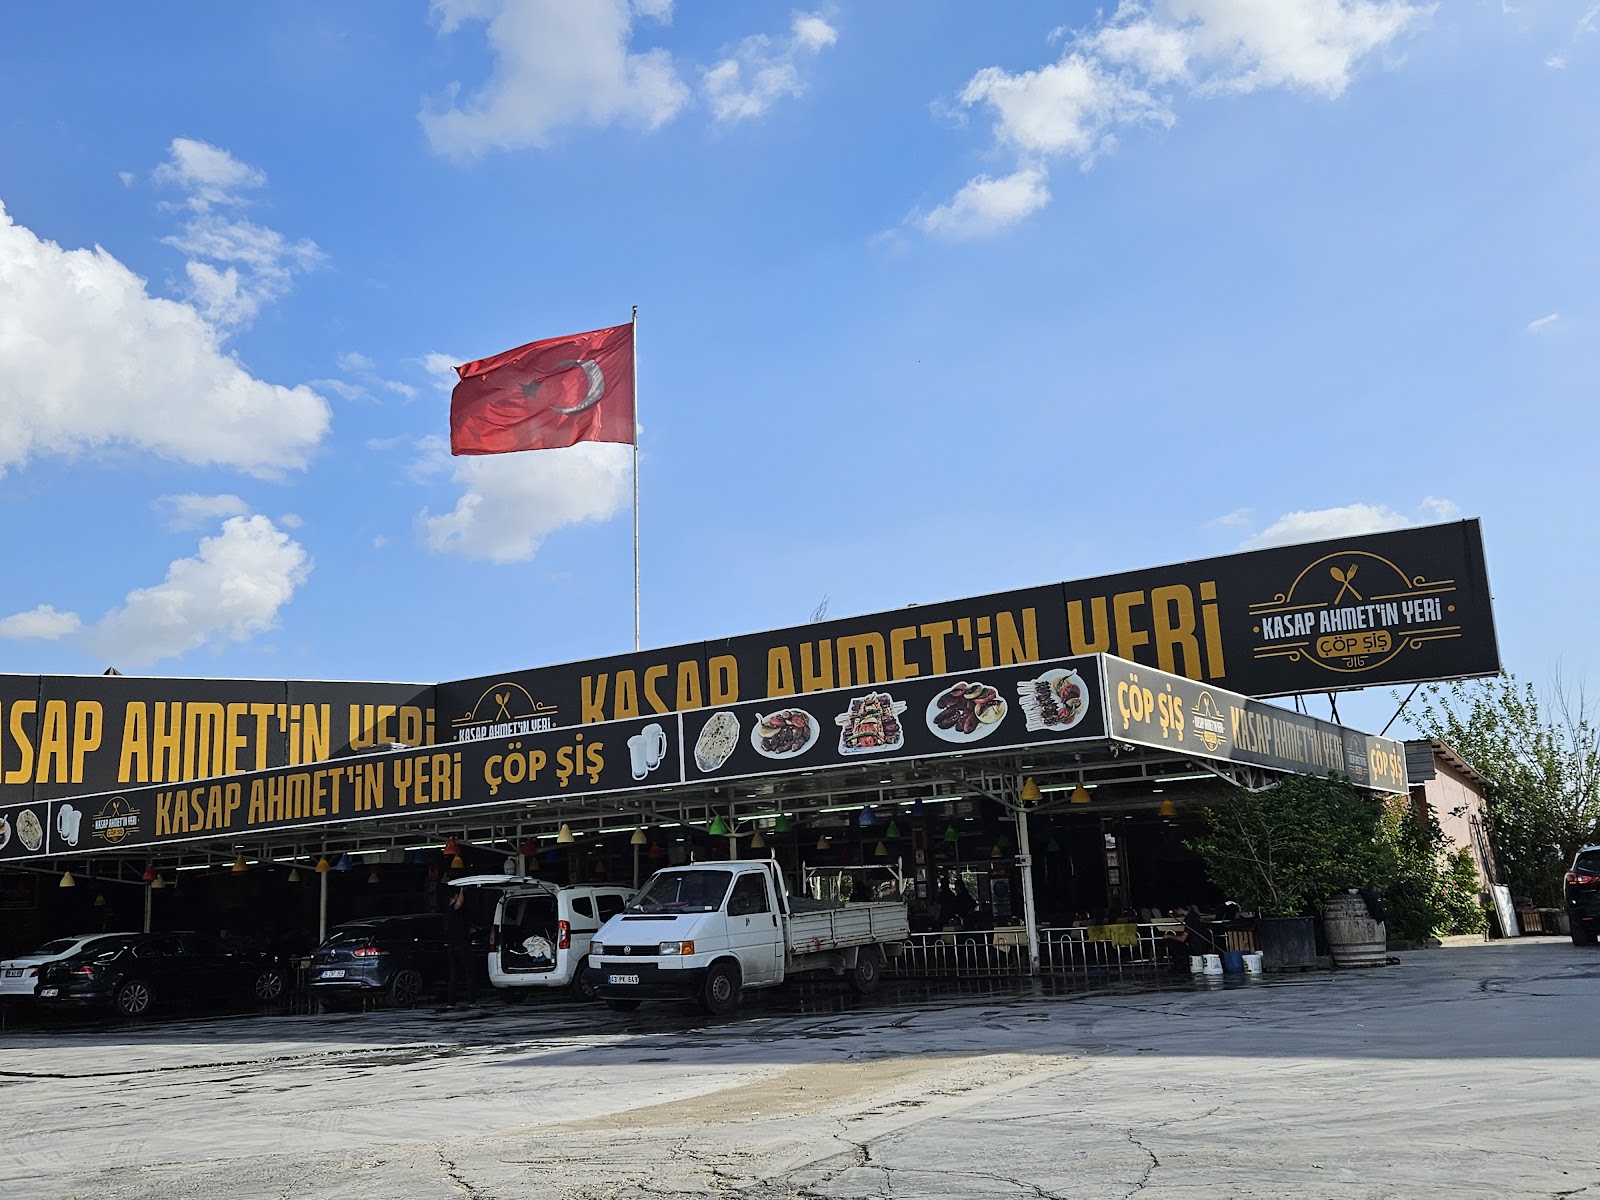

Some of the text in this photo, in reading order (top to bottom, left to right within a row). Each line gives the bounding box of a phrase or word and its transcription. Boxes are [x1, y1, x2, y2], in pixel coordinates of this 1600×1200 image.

[1261, 611, 1316, 640] KASAP
[1402, 597, 1442, 624] YERİ
[1320, 632, 1388, 657] ÇÖP ŞİŞ
[1117, 672, 1185, 741] ÇÖP ŞİŞ
[1230, 705, 1271, 754] KASAP
[0, 699, 104, 785] SAP
[484, 733, 606, 796] ÇÖP ŞİŞ
[1370, 741, 1389, 783] ÇÖP
[155, 781, 242, 836] KASAP
[393, 752, 462, 807] YERİ
